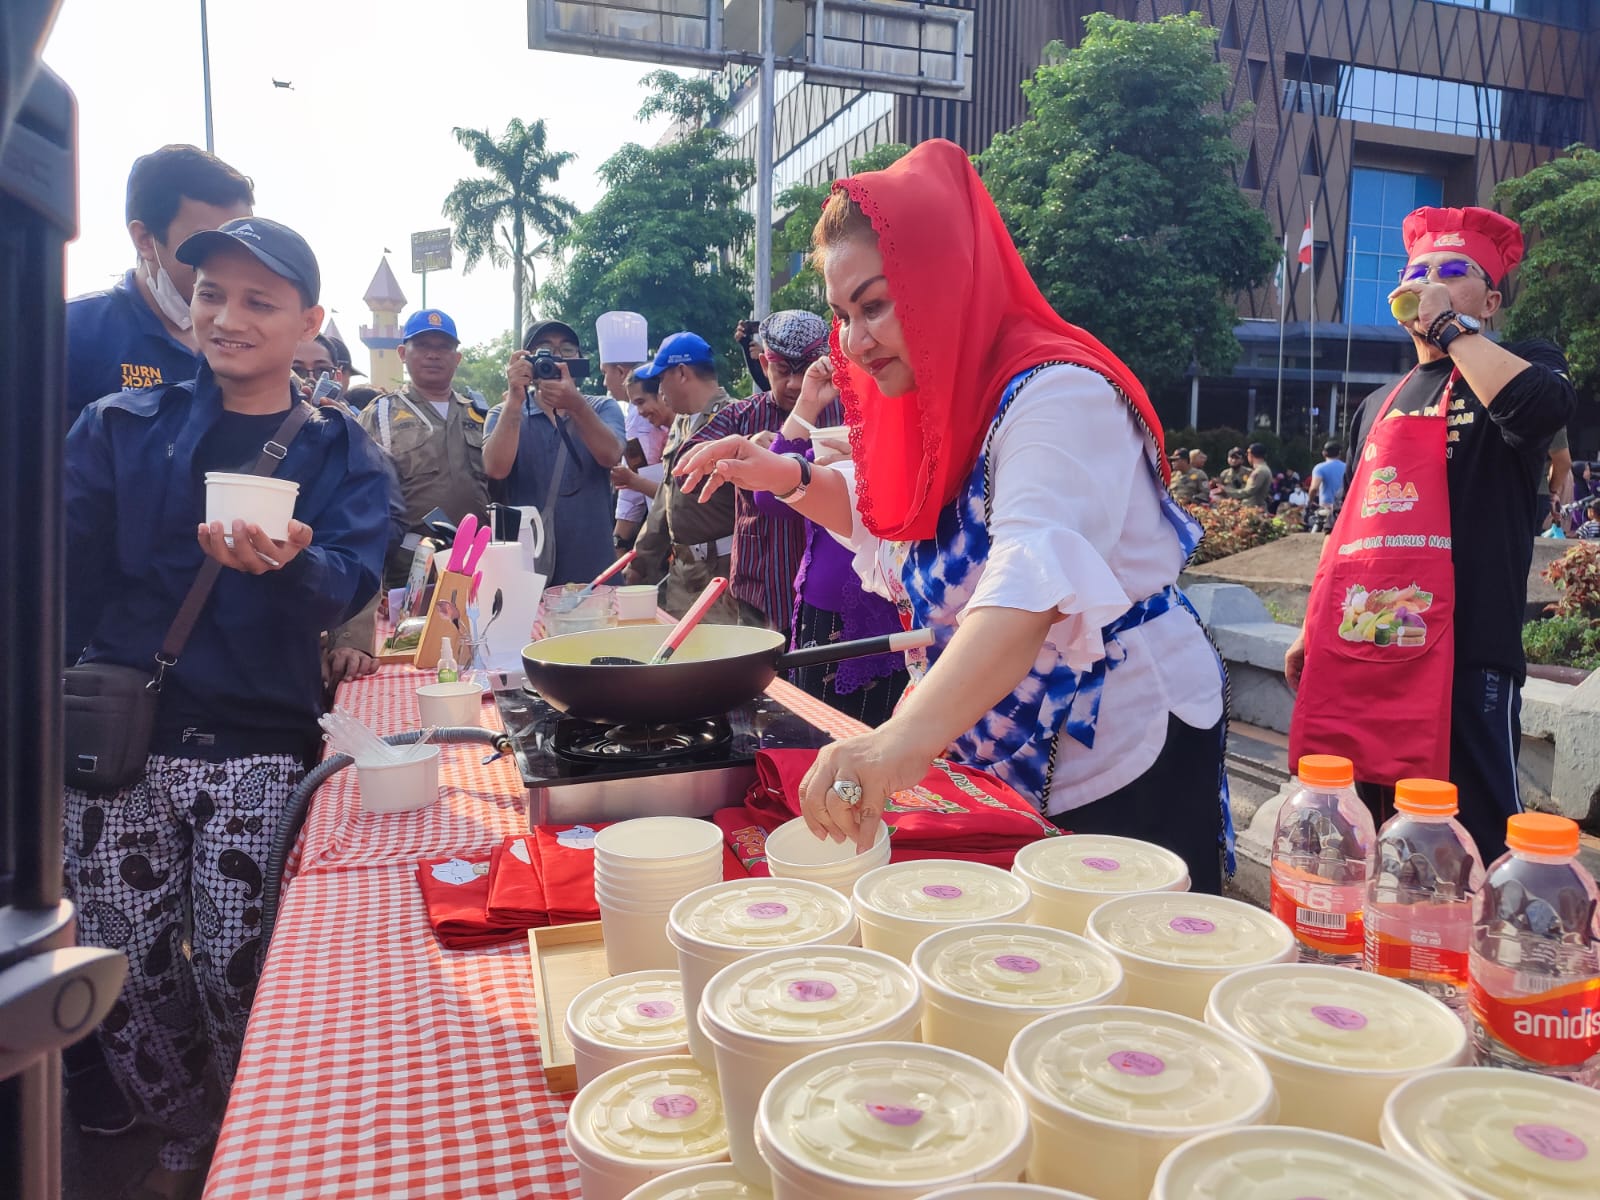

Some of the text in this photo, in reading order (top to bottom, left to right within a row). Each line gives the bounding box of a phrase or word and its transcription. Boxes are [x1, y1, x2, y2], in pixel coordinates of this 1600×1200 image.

[121, 364, 162, 379] TURN
[1368, 482, 1419, 504] B2SA
[1385, 534, 1427, 548] HARUS
